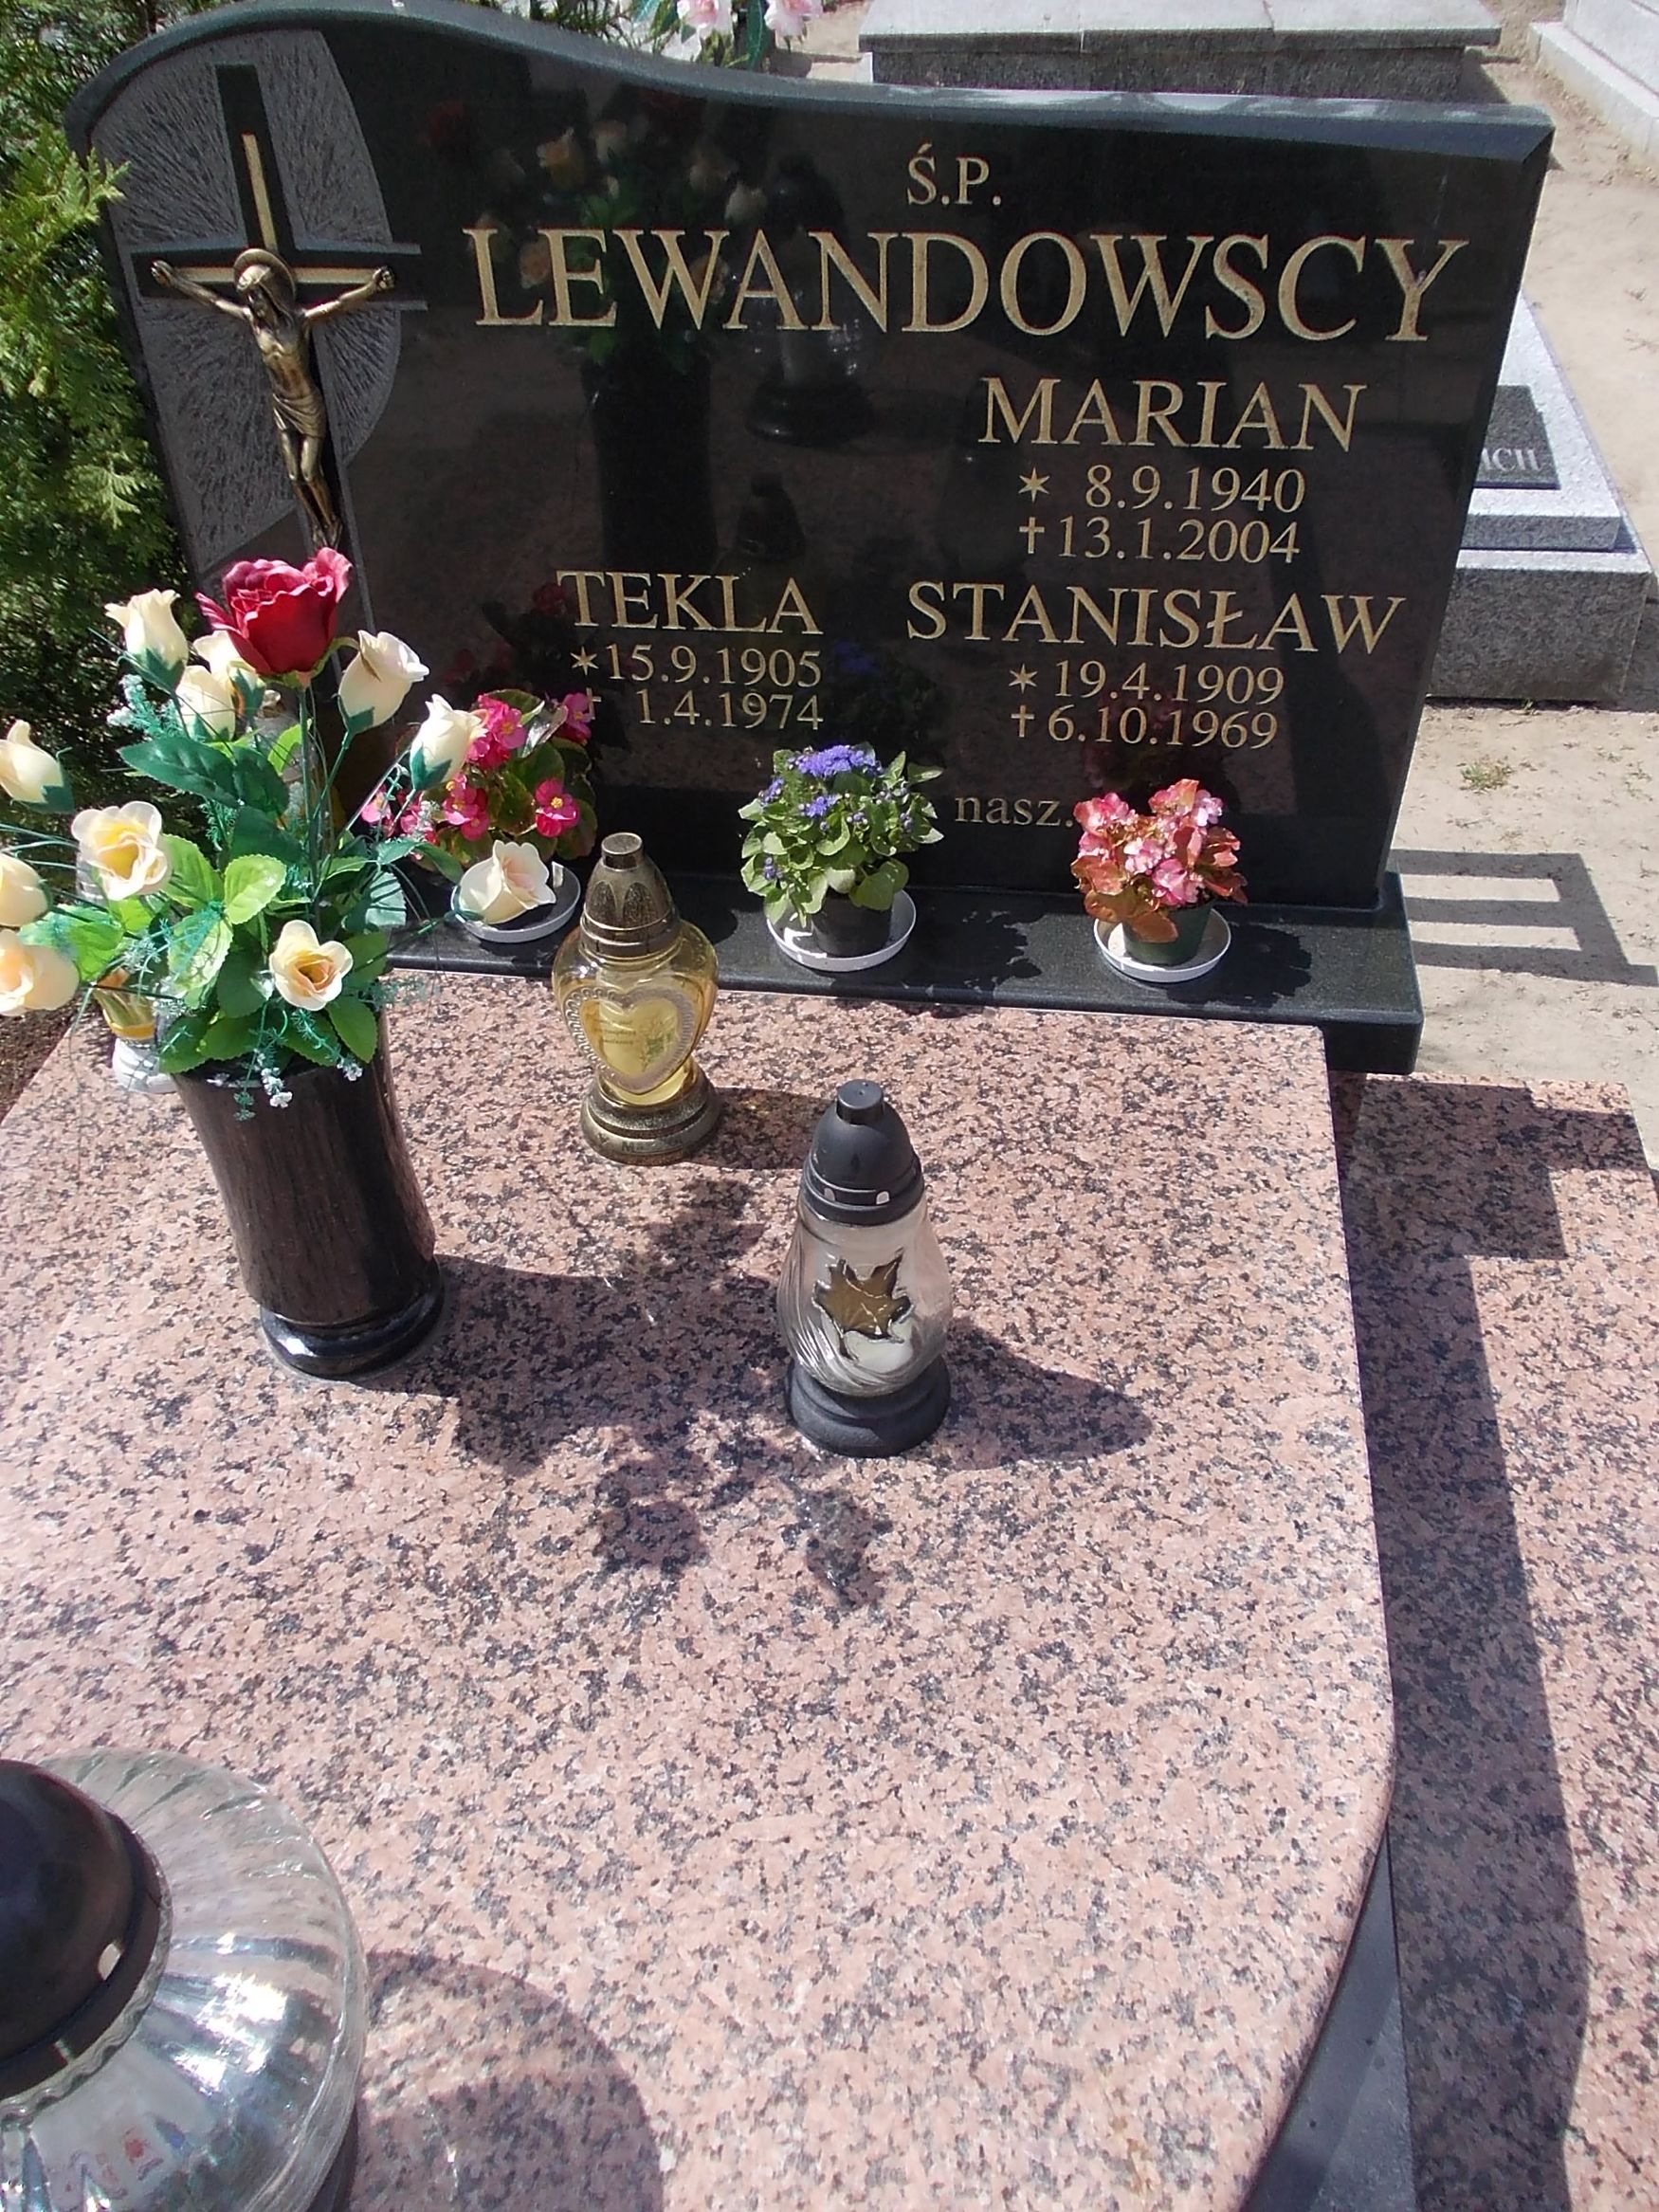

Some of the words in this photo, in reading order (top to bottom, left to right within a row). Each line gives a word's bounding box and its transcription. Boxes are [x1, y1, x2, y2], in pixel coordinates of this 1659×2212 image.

[907, 143, 1002, 206] Ś.P.
[462, 228, 1469, 341] LEWANDOWSCY
[977, 377, 1367, 452] MARIAN
[1085, 464, 1305, 513] 8.9.1940
[1057, 515, 1300, 564] 13.1.2004
[556, 570, 825, 635] TEKLA
[906, 580, 1407, 654] STANISŁAW
[606, 644, 822, 687] 15.9.1905
[1054, 660, 1285, 705] 19.4.1909
[636, 688, 824, 731] 1.4.1974
[1048, 704, 1279, 749] 6.10.1969
[954, 796, 1074, 828] nasz.
